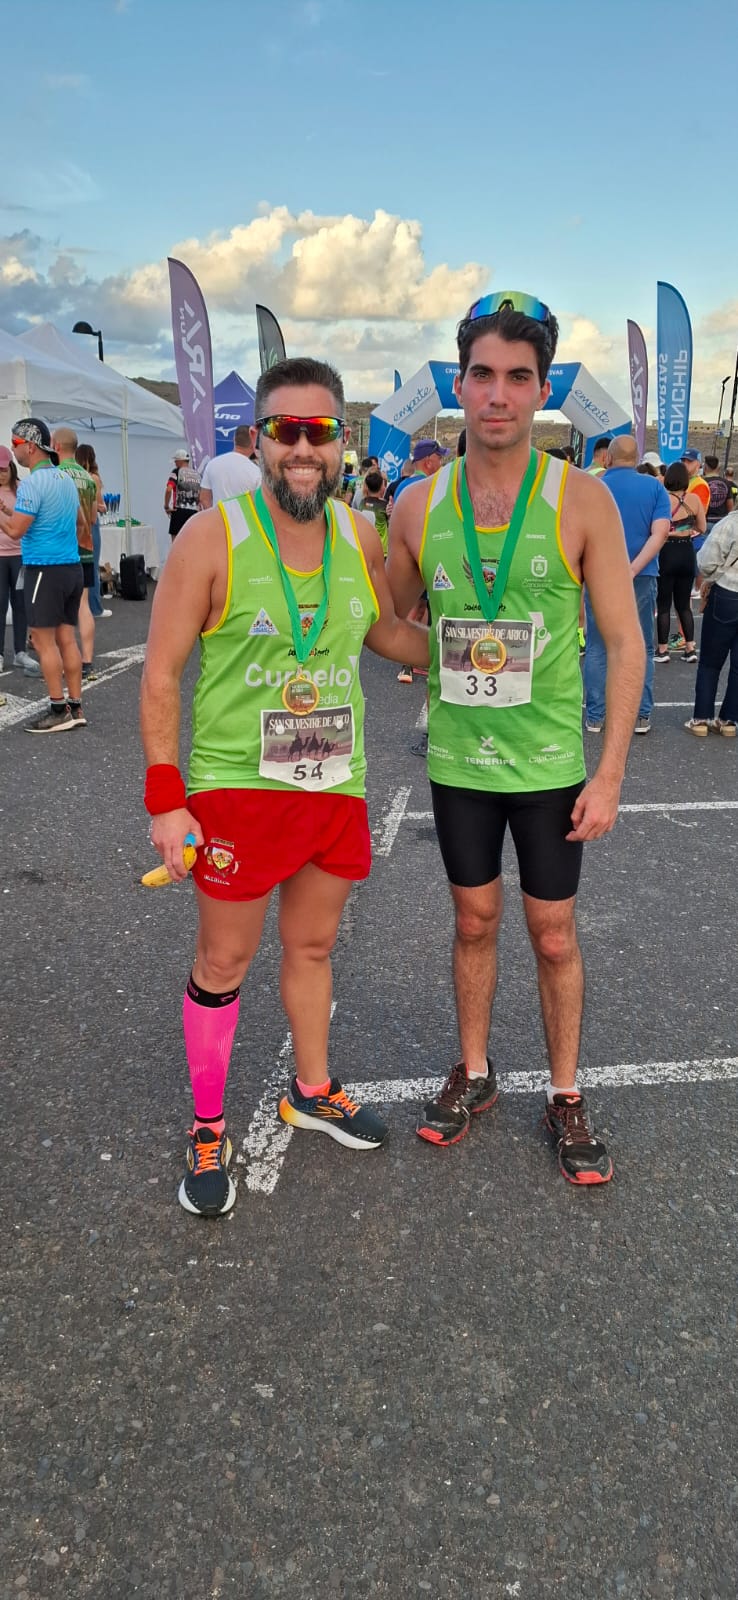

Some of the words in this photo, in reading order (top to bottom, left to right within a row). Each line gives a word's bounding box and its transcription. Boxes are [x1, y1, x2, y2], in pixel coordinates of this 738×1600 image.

[445, 626, 457, 638] SAN
[496, 629, 506, 640] DE
[466, 675, 497, 696] 33
[284, 717, 322, 730] SILVESTRE
[322, 716, 332, 728] DE
[465, 757, 516, 766] TENERIFE
[293, 762, 323, 780] 54
